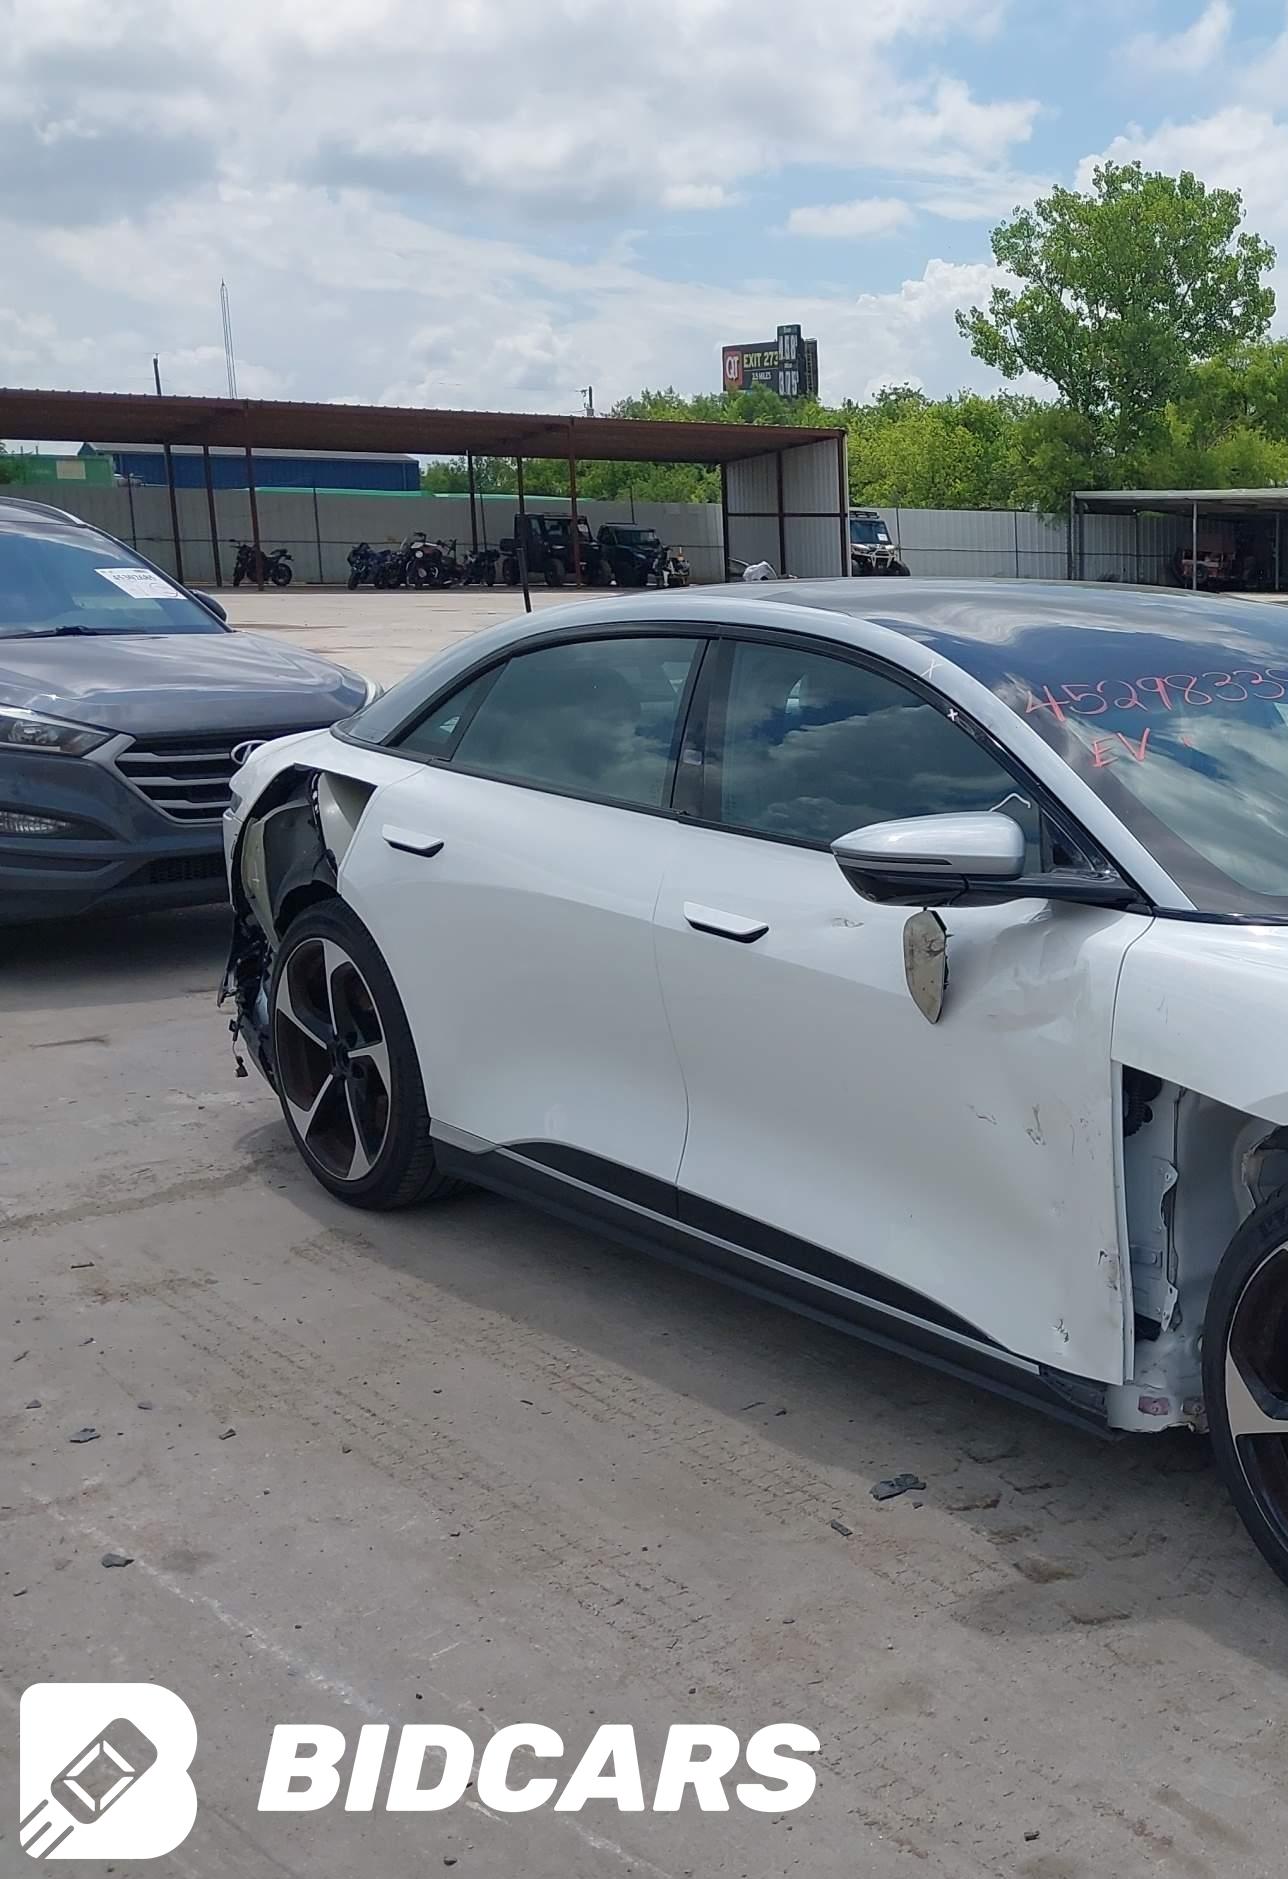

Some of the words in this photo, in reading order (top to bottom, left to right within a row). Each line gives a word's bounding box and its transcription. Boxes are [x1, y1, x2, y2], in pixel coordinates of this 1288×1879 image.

[726, 356, 739, 380] QT
[743, 353, 762, 368] EXIT
[763, 350, 778, 367] 273
[1092, 727, 1150, 767] EV
